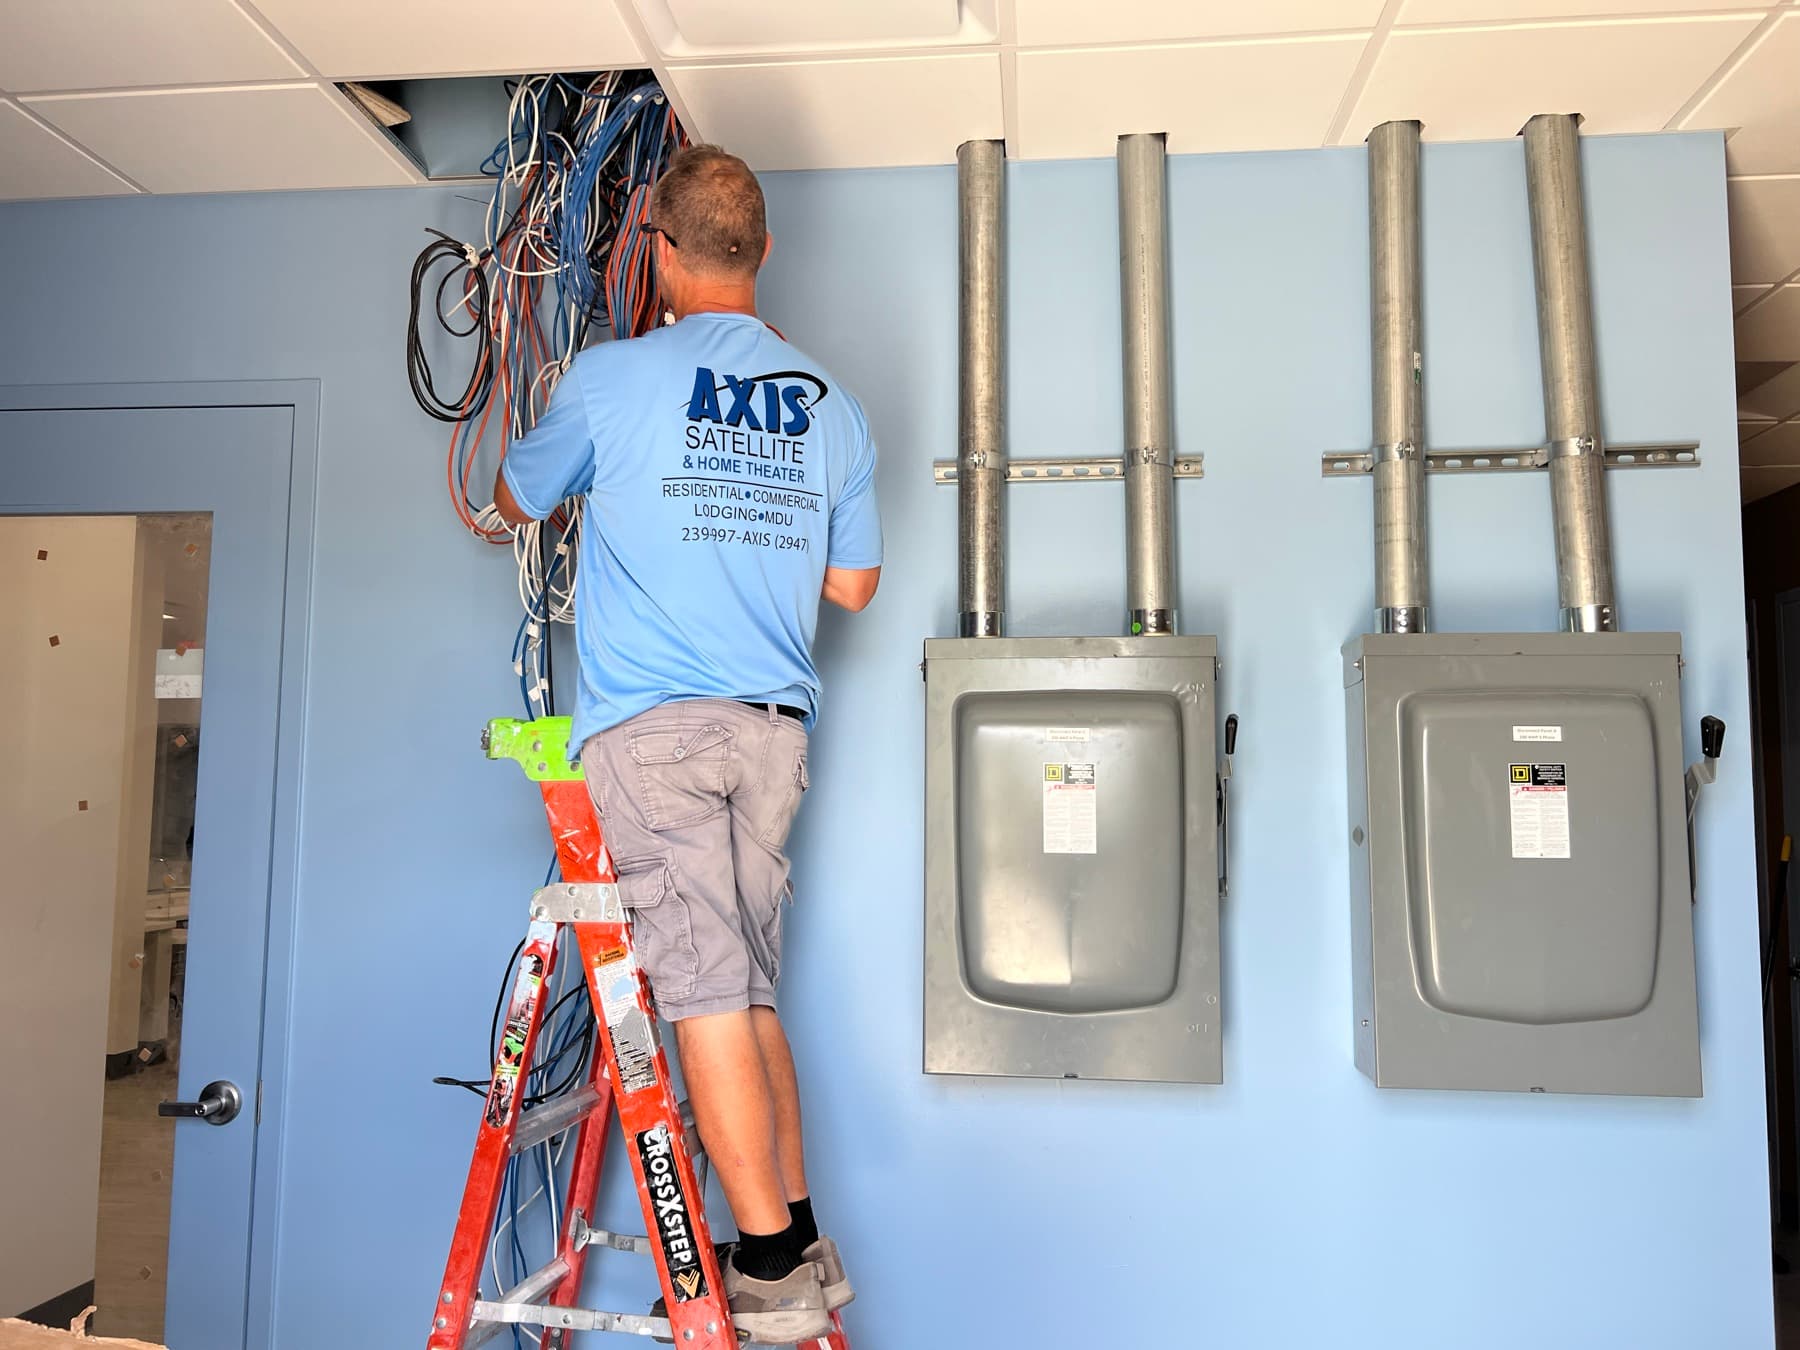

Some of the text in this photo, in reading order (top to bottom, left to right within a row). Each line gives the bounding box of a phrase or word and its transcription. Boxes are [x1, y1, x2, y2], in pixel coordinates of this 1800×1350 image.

[686, 367, 810, 436] AXIS
[685, 426, 805, 464] SATELLITE
[683, 455, 805, 484] & HOME THEATER
